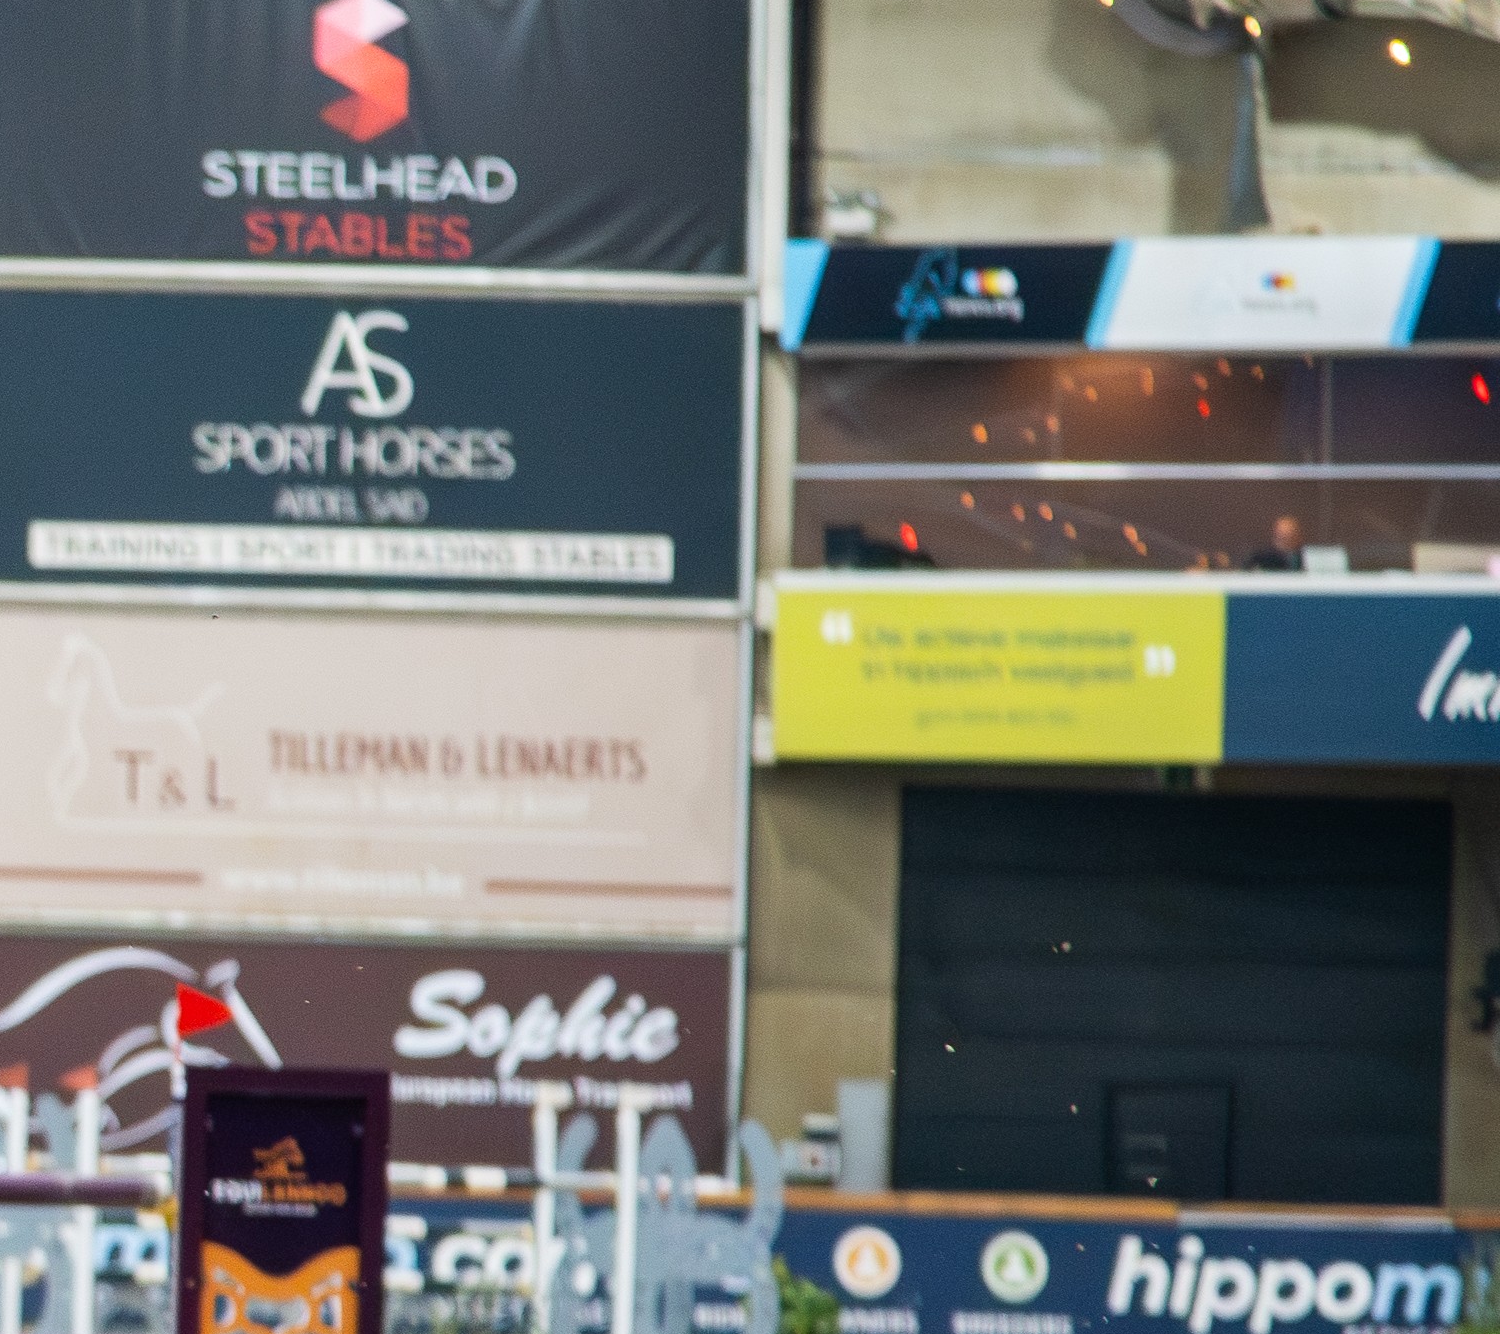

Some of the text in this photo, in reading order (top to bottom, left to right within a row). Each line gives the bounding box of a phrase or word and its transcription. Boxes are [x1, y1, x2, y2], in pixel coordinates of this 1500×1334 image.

[201, 149, 518, 205] STEELHEAD
[243, 209, 474, 260] STABLES
[299, 309, 417, 420] AS
[191, 421, 517, 481] SPORT HORSES
[47, 530, 665, 574] TRAINING SPORT TRADING STABLES
[112, 747, 156, 806] T
[156, 767, 188, 811] &
[205, 754, 237, 813] L
[267, 729, 432, 778] TILLEMAN
[476, 734, 649, 784] LENAERTS
[391, 968, 681, 1081] Sophie
[390, 1073, 498, 1108] uropean
